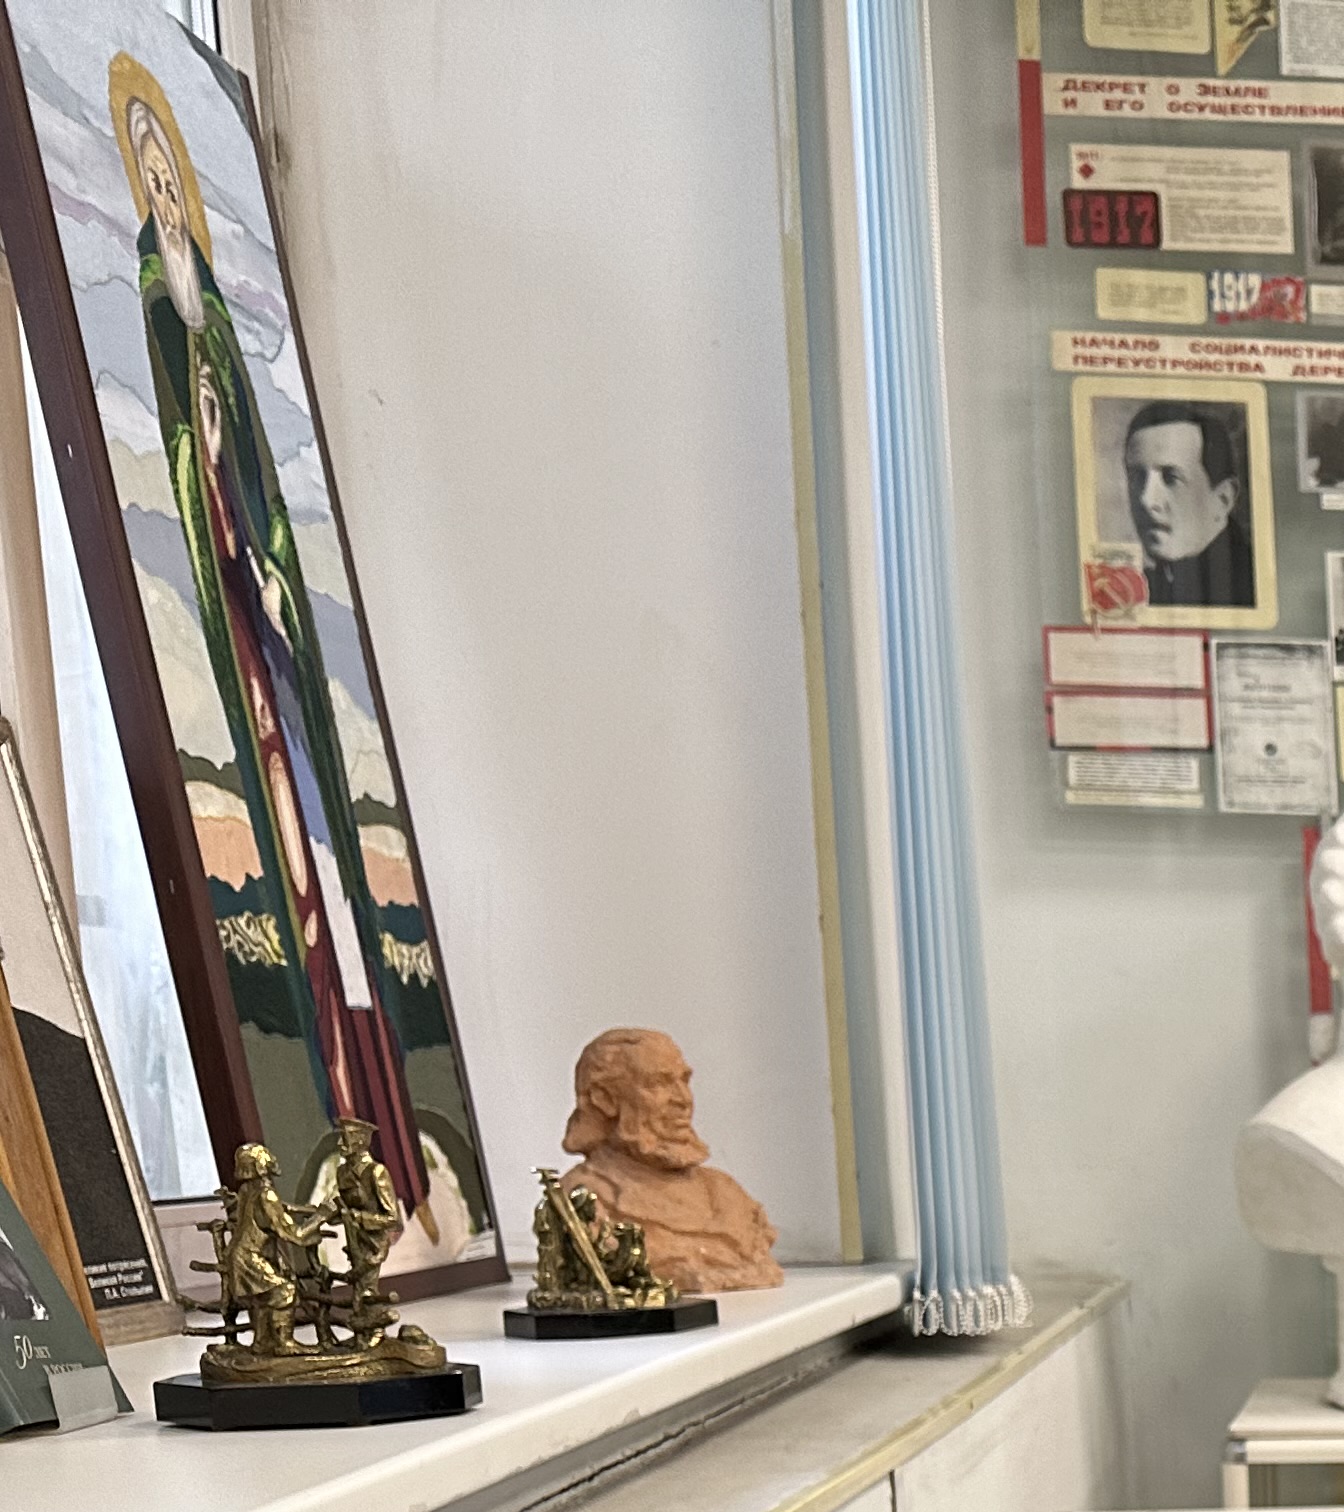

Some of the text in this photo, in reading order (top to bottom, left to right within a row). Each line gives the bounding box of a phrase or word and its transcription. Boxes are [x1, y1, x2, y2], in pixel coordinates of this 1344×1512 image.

[1061, 79, 1270, 99] ДЕКРЕТ О ЗЕМЛЕ
[1062, 99, 1078, 111] И
[1103, 100, 1145, 113] ЕГО
[1210, 270, 1263, 313] 1917
[1071, 337, 1160, 352] НАЧАЛО
[1072, 355, 1265, 374] ПЕРЕУСТРОЙСТВА
[14, 1335, 33, 1369] 50
